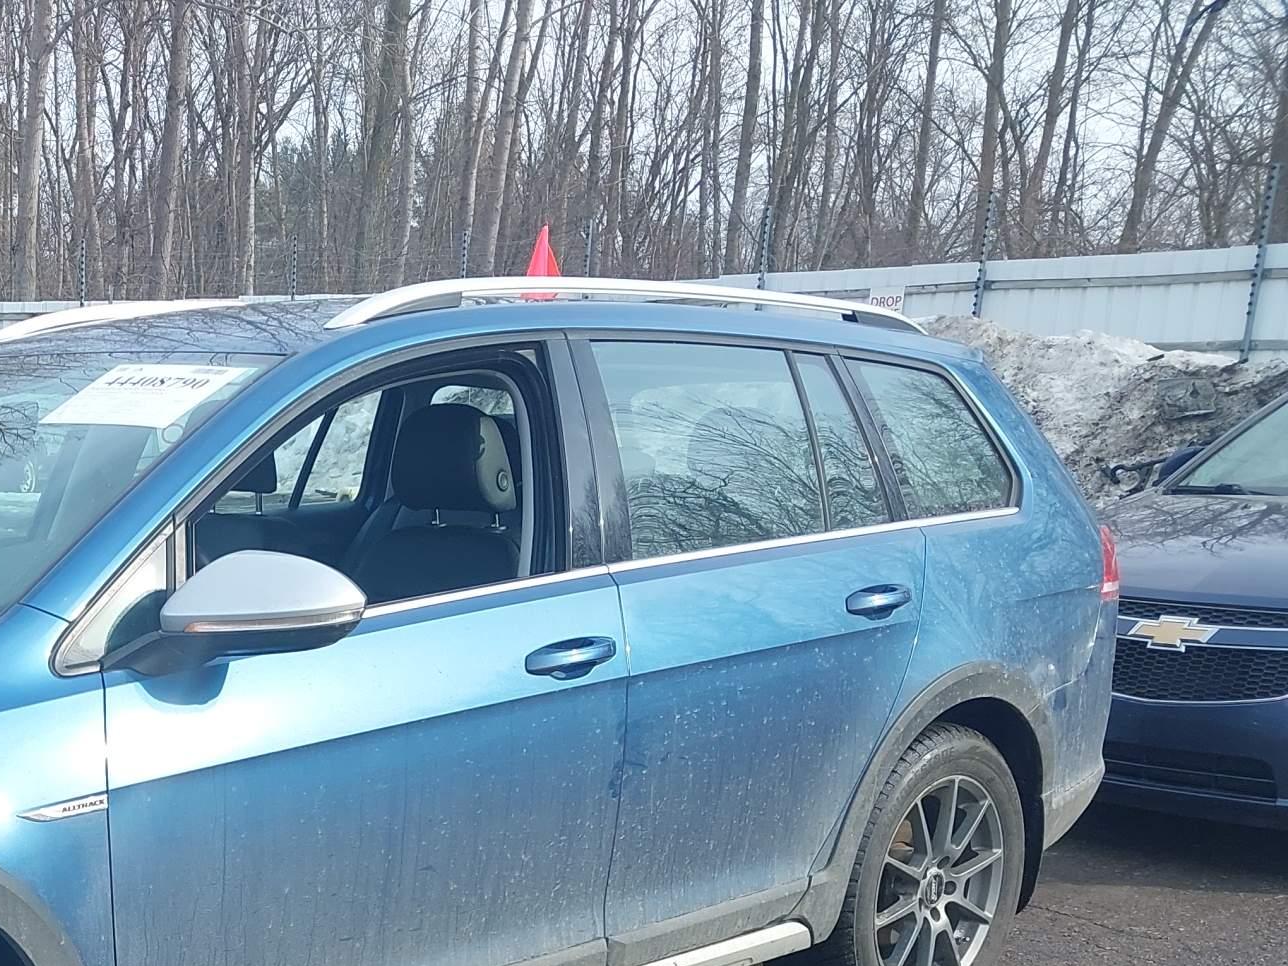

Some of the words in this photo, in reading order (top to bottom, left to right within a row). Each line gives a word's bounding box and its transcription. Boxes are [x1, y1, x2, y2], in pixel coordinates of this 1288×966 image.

[871, 295, 902, 308] DROP
[104, 375, 210, 390] 44408790
[61, 798, 105, 813] ALLTRACK
